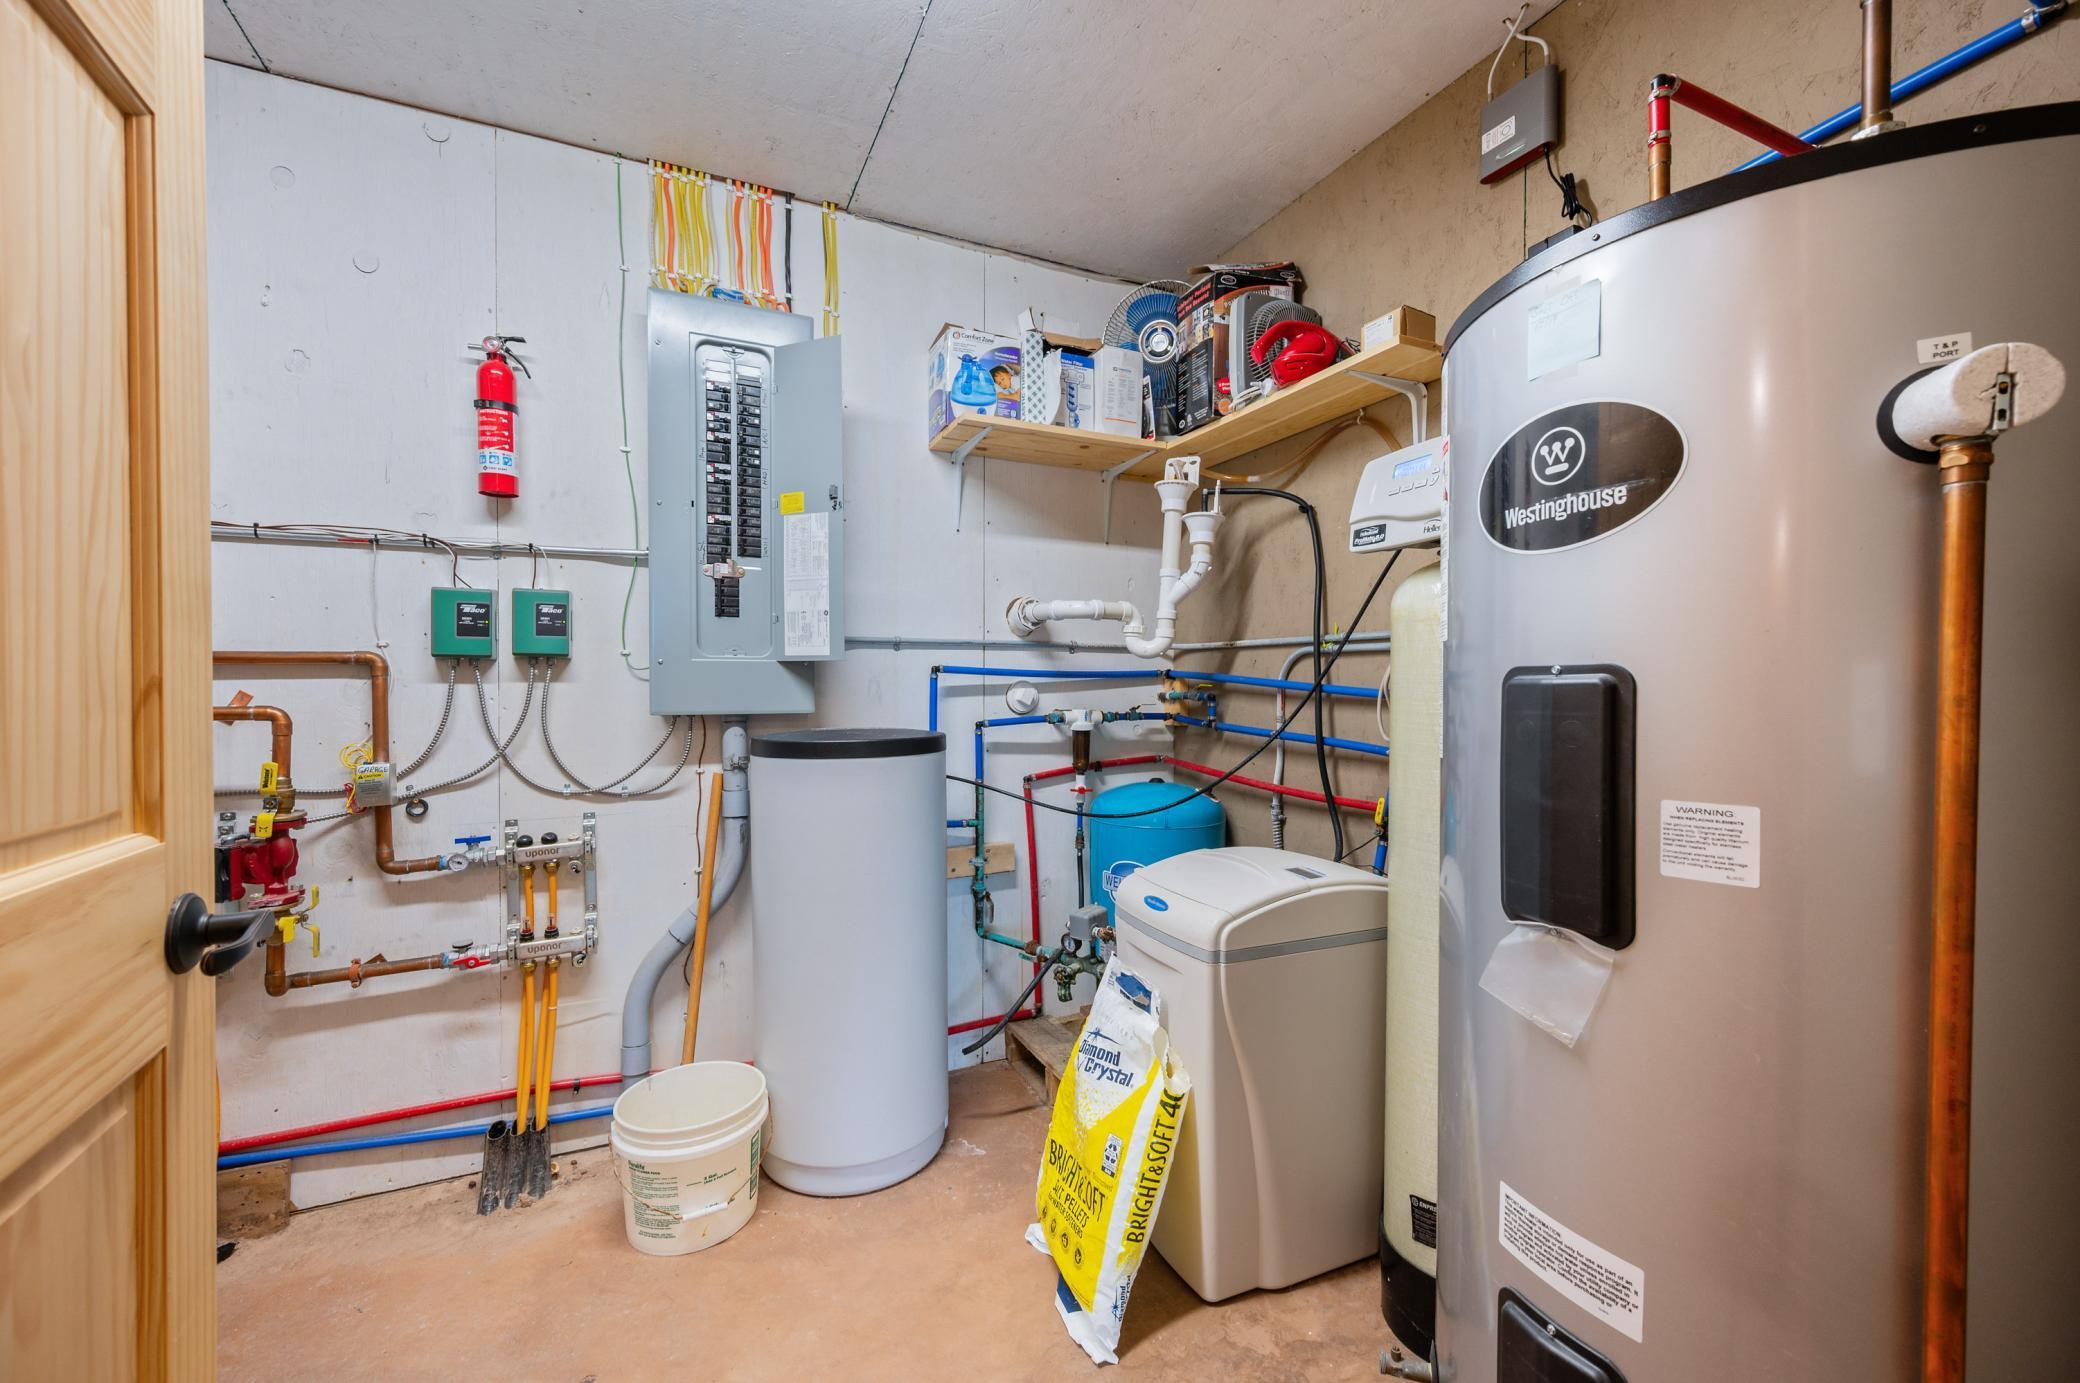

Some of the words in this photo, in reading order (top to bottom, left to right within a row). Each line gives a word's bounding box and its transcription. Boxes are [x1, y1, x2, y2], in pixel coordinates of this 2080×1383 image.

[1932, 349, 1960, 359] PORT
[1505, 485, 1628, 529] Westinghouse
[460, 604, 487, 613] Taco
[538, 604, 563, 614] Taco
[1676, 806, 1733, 817] WARNING
[525, 848, 560, 858] uponor
[527, 943, 561, 954] uponor
[1078, 1039, 1121, 1066] Diamond
[1084, 1057, 1134, 1087] Crystal
[1049, 1138, 1106, 1222] BRIGHT&OFT
[1126, 1117, 1176, 1244] BRIGHT&SOFT
[1064, 1193, 1090, 1229] PELLETS
[1528, 1211, 1560, 1237] INFORMATION
[1565, 1256, 1577, 1268] water
[1579, 1265, 1596, 1280] unless
[1598, 1276, 1622, 1294] enrolled
[1579, 1258, 1603, 1279] response
[1585, 1256, 1594, 1265] use
[1604, 1267, 1615, 1278] part
[1617, 1274, 1623, 1282] of
[1573, 1267, 1584, 1279] your
[1586, 1275, 1601, 1290] utility
[1603, 1286, 1630, 1306] company
[1574, 1280, 1604, 1305] purchasing
[1578, 1276, 1586, 1286] the
[1588, 1282, 1618, 1307] availability
[1620, 1301, 1626, 1309] of
